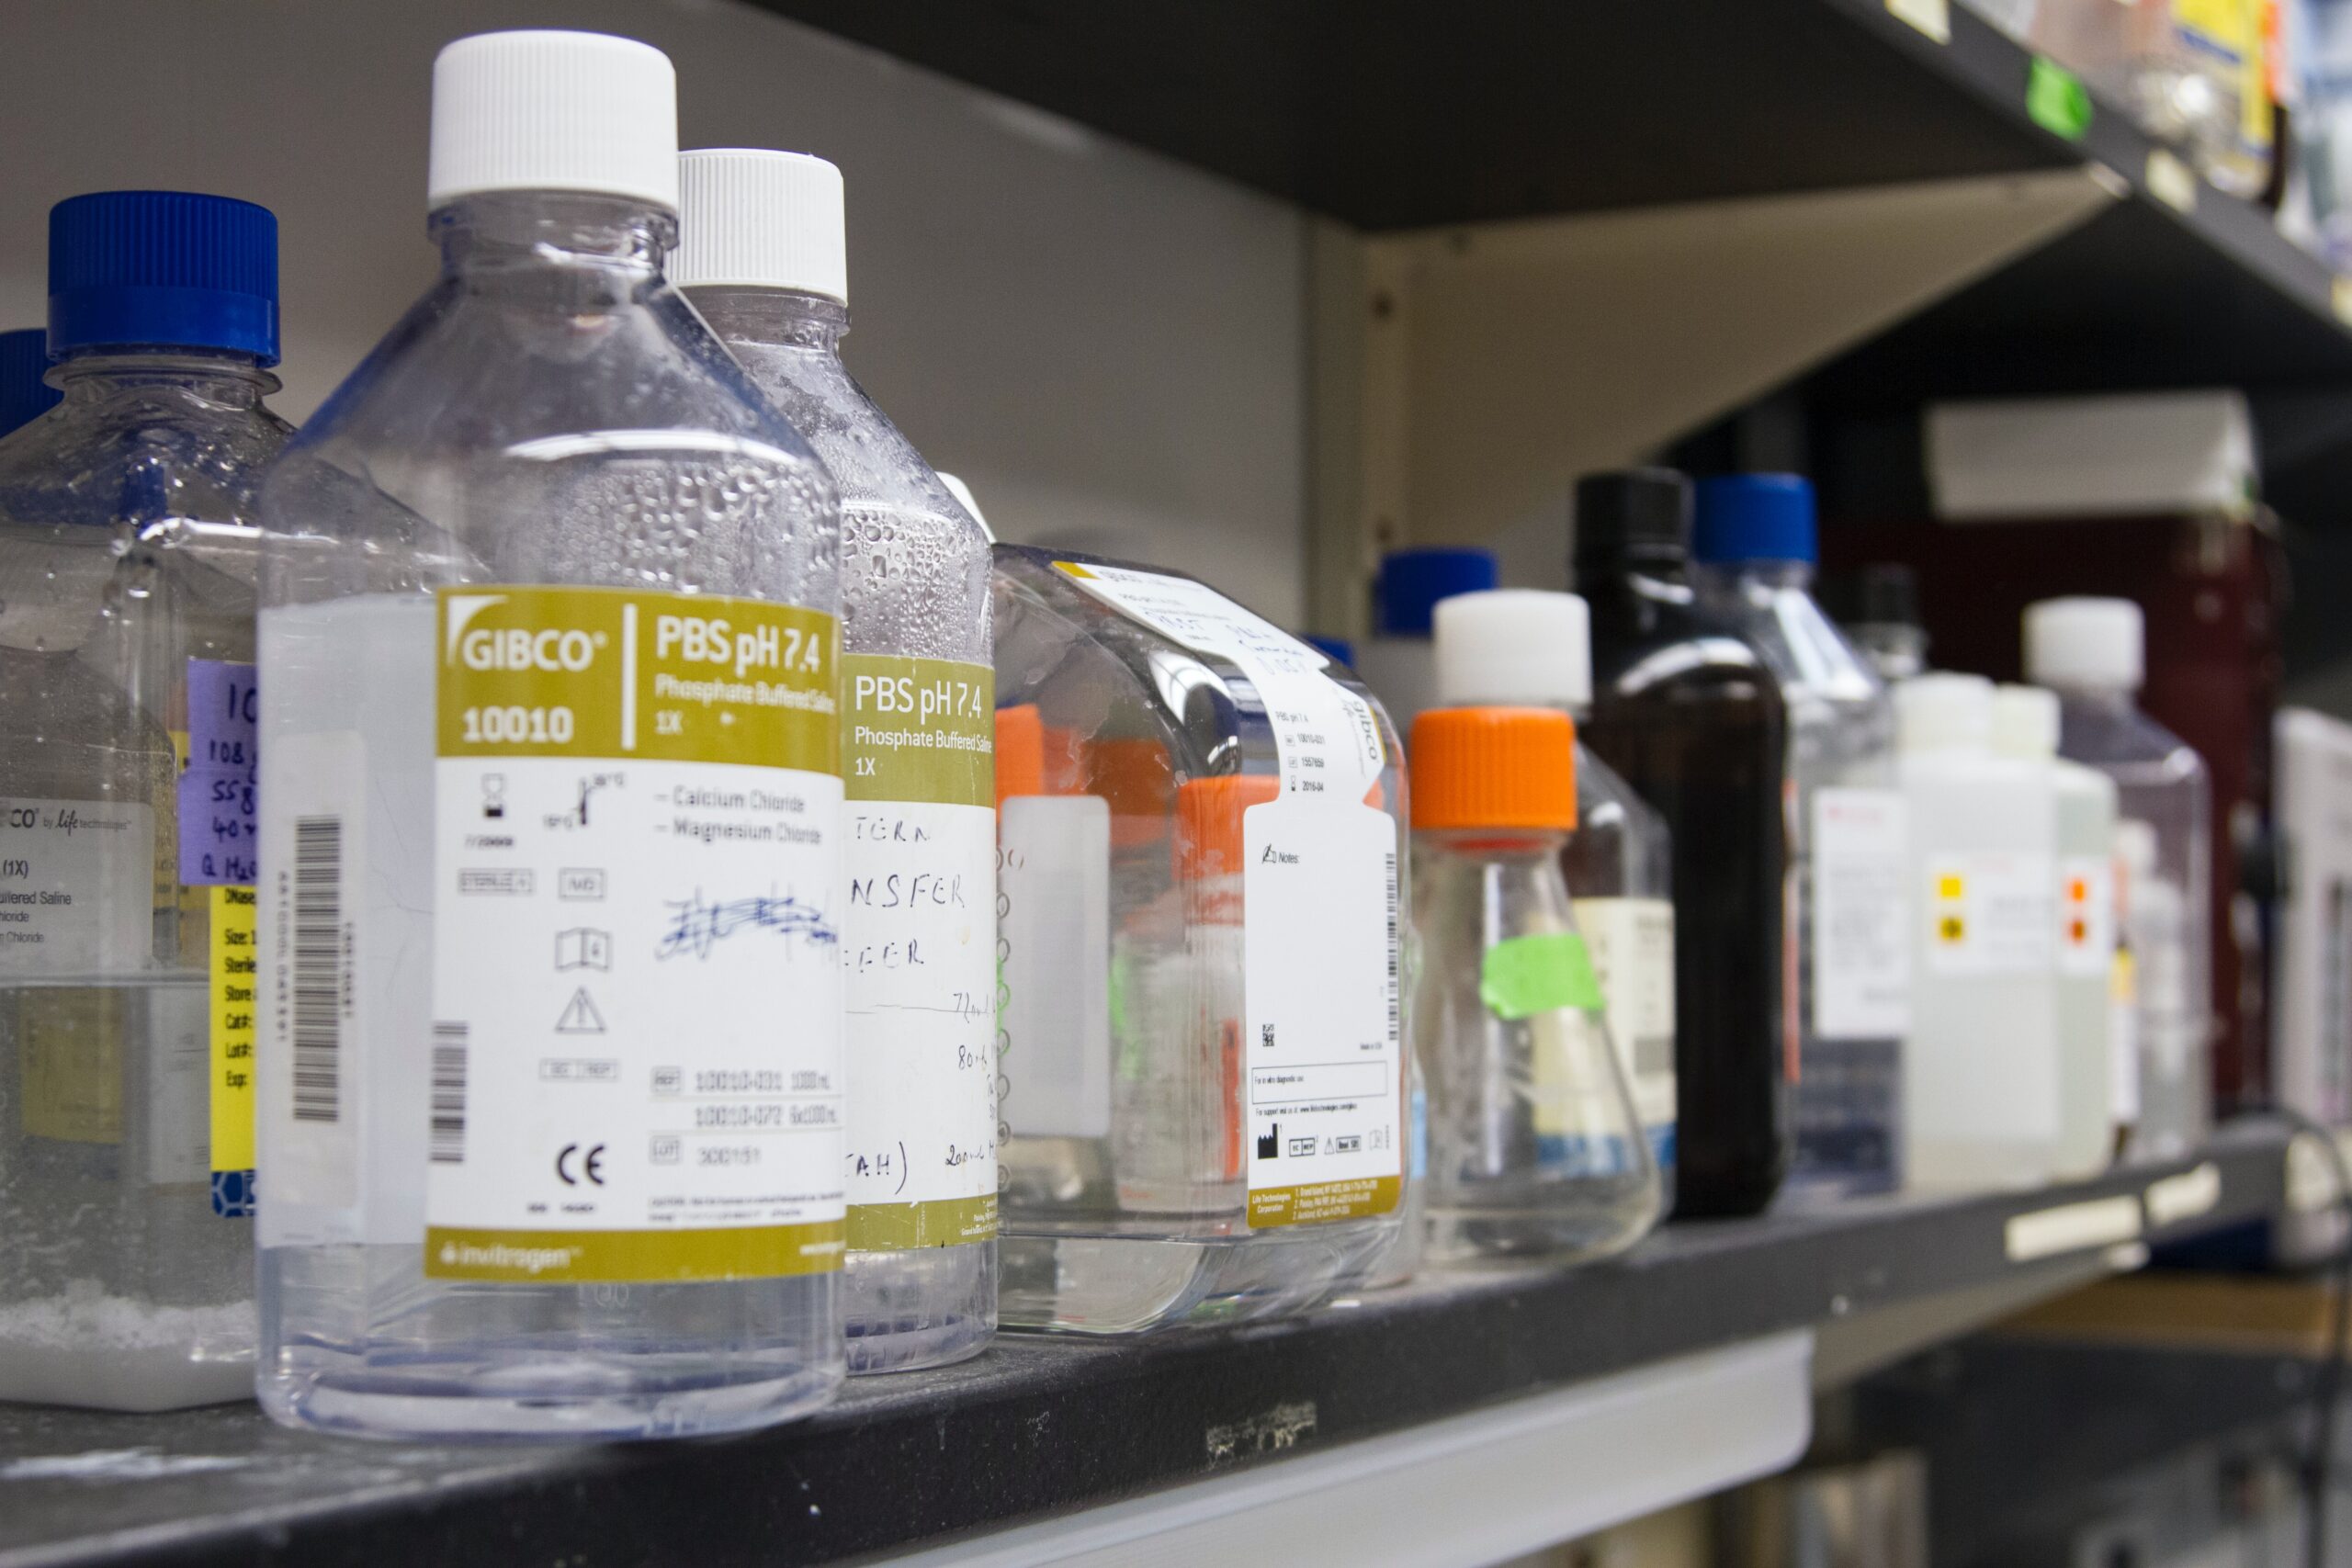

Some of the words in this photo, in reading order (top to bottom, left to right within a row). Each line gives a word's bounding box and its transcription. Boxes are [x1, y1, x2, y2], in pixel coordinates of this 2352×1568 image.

[656, 615, 730, 663] PBS
[735, 625, 778, 677] pH
[783, 629, 820, 673] 7.4
[656, 673, 754, 708] Phosphate
[856, 675, 914, 713] PBS
[921, 681, 951, 725] pH
[957, 682, 982, 718] 7.4
[463, 705, 574, 742] 10010
[656, 711, 683, 734] 1X
[855, 726, 933, 751] Phosphate
[936, 730, 976, 750] Buffered
[855, 757, 875, 775] 1X
[673, 785, 744, 807] Calcium
[750, 790, 804, 813] Chloride
[55, 809, 79, 837] life
[673, 818, 772, 844] Magnesium
[3, 859, 28, 879] (1X)
[40, 891, 72, 905] Saline
[1257, 1203, 1283, 1213] Corporation
